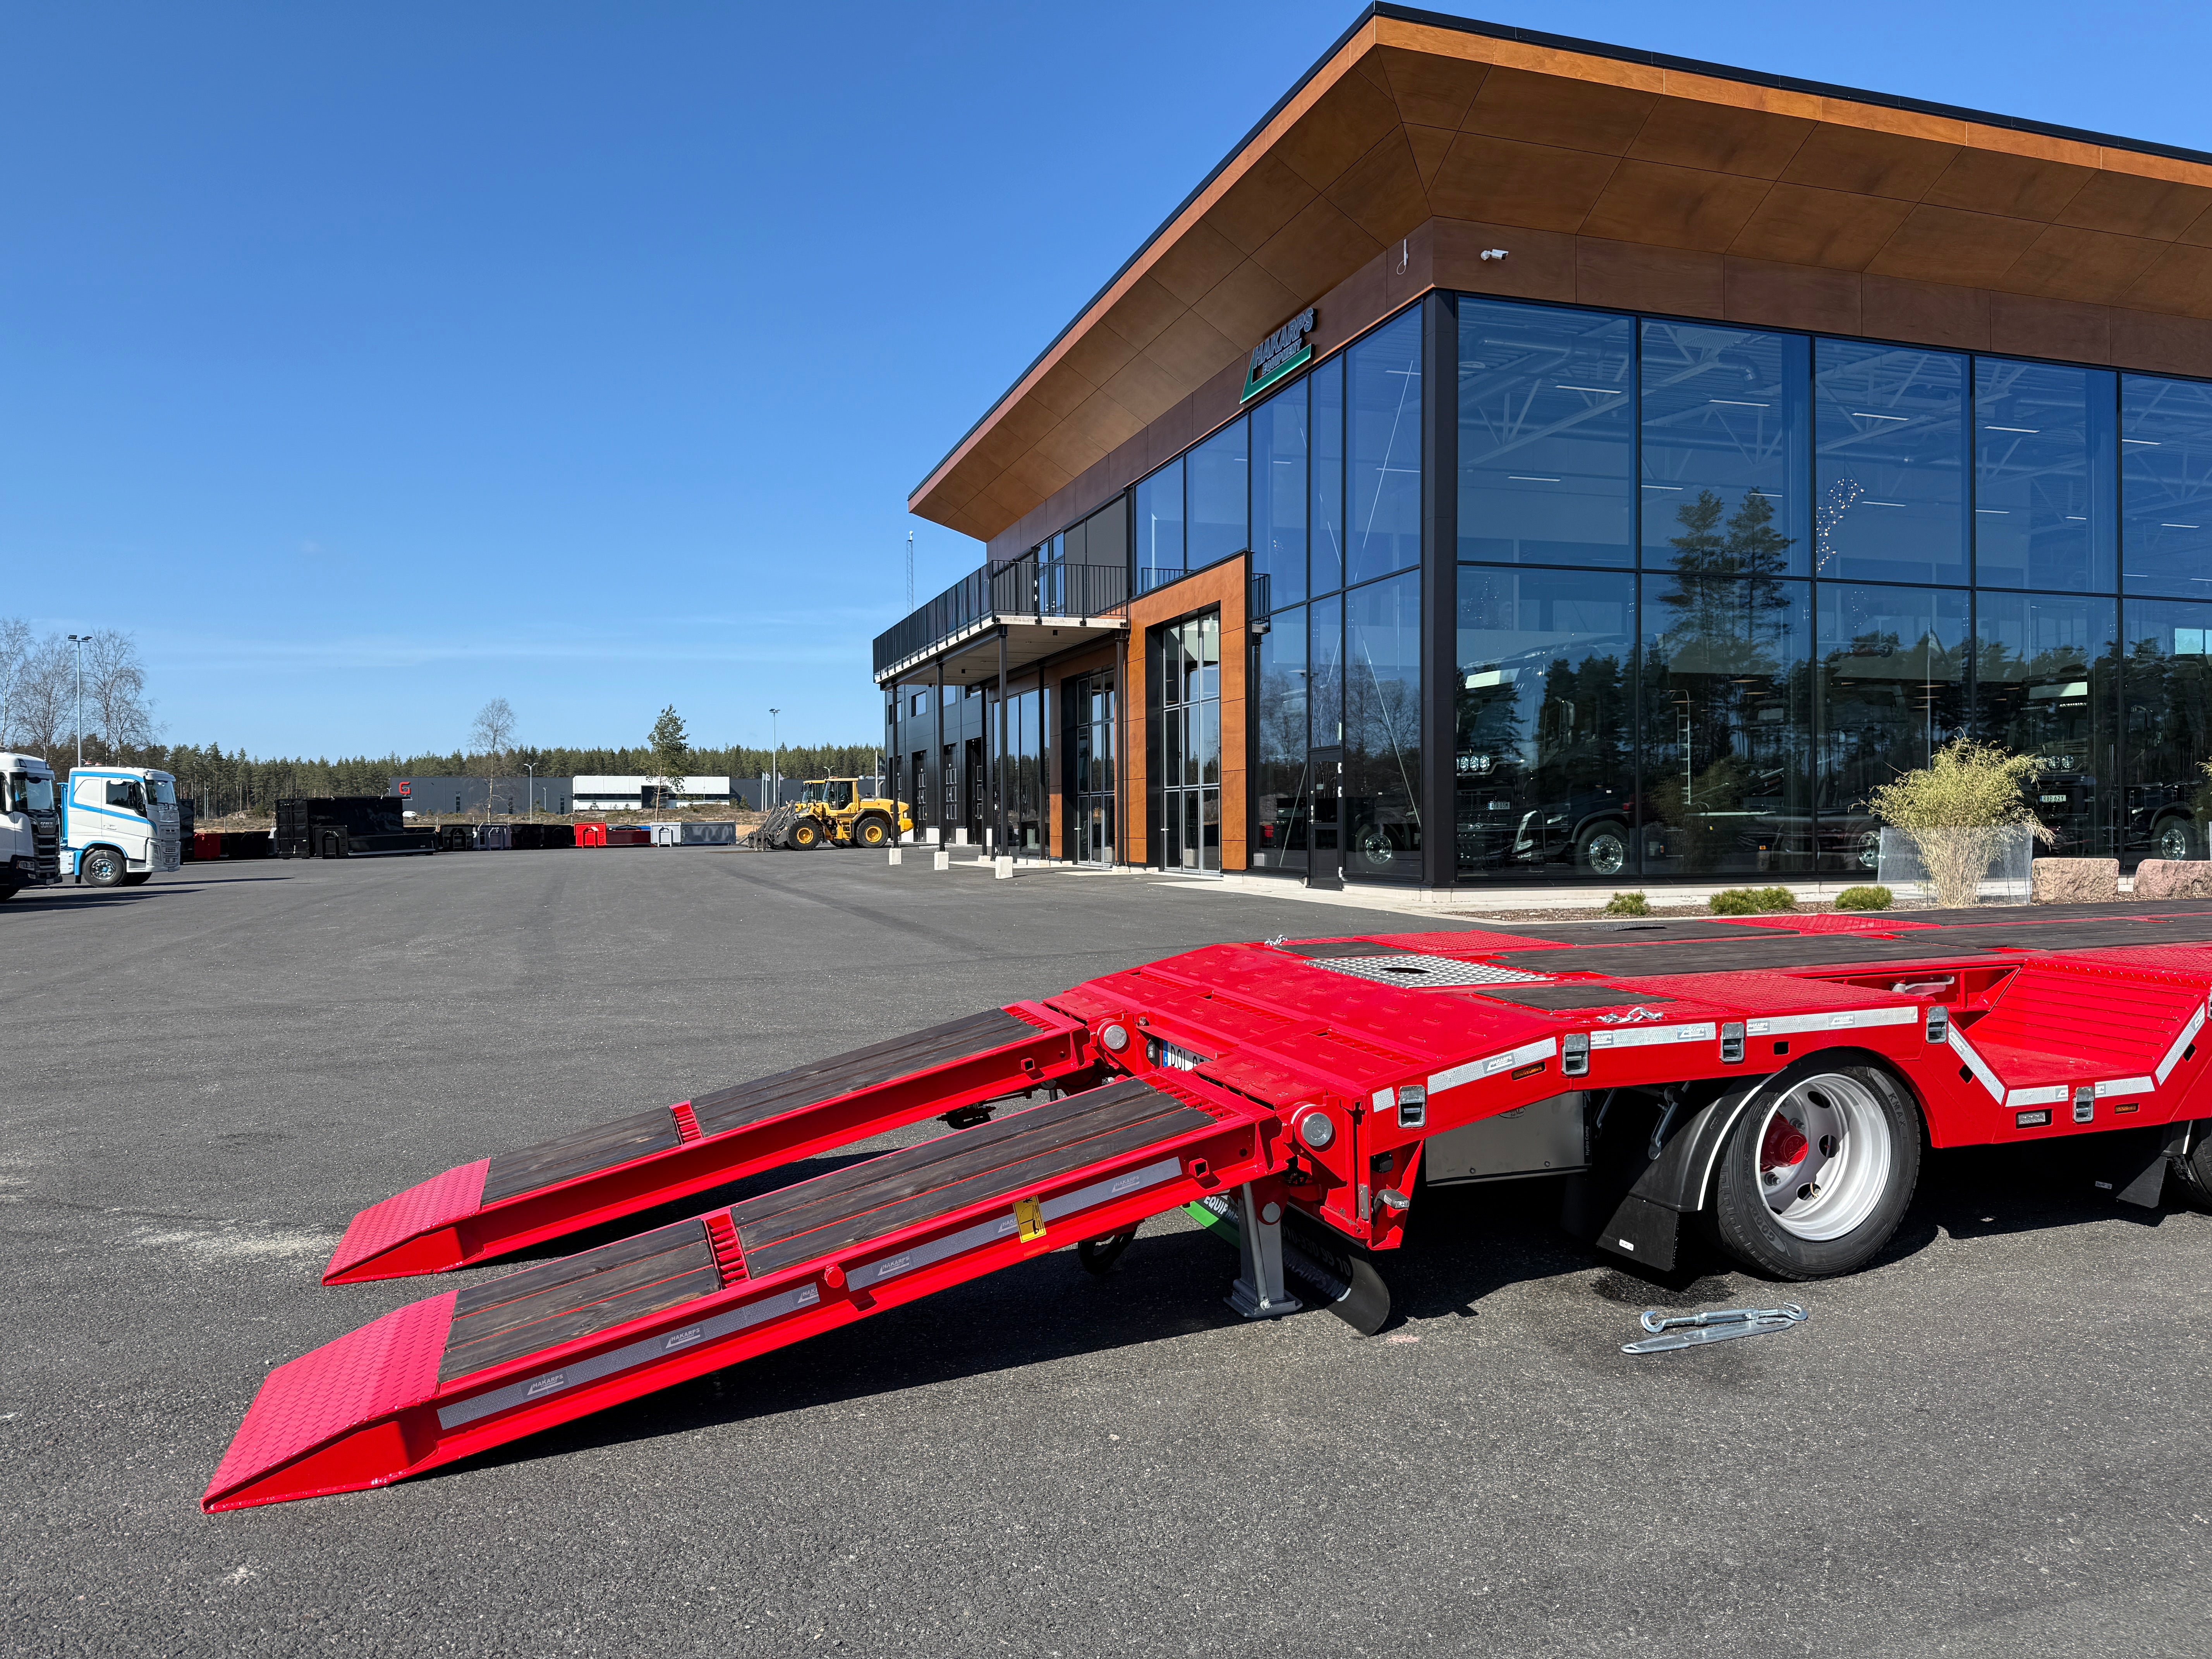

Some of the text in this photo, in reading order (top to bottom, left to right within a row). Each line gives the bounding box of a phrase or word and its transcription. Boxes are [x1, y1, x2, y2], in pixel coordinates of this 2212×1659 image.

[1254, 307, 1314, 368] HAKARPS
[1262, 338, 1302, 376] EQUIPMENT
[1490, 1055, 1512, 1066] HAKARPS
[1888, 1093, 1906, 1127] KMAX
[1115, 1175, 1139, 1187] HAKARPS
[883, 1256, 909, 1269] HAKARPS
[671, 1328, 700, 1342] HAKARPS
[533, 1374, 563, 1389] HAKARPS
